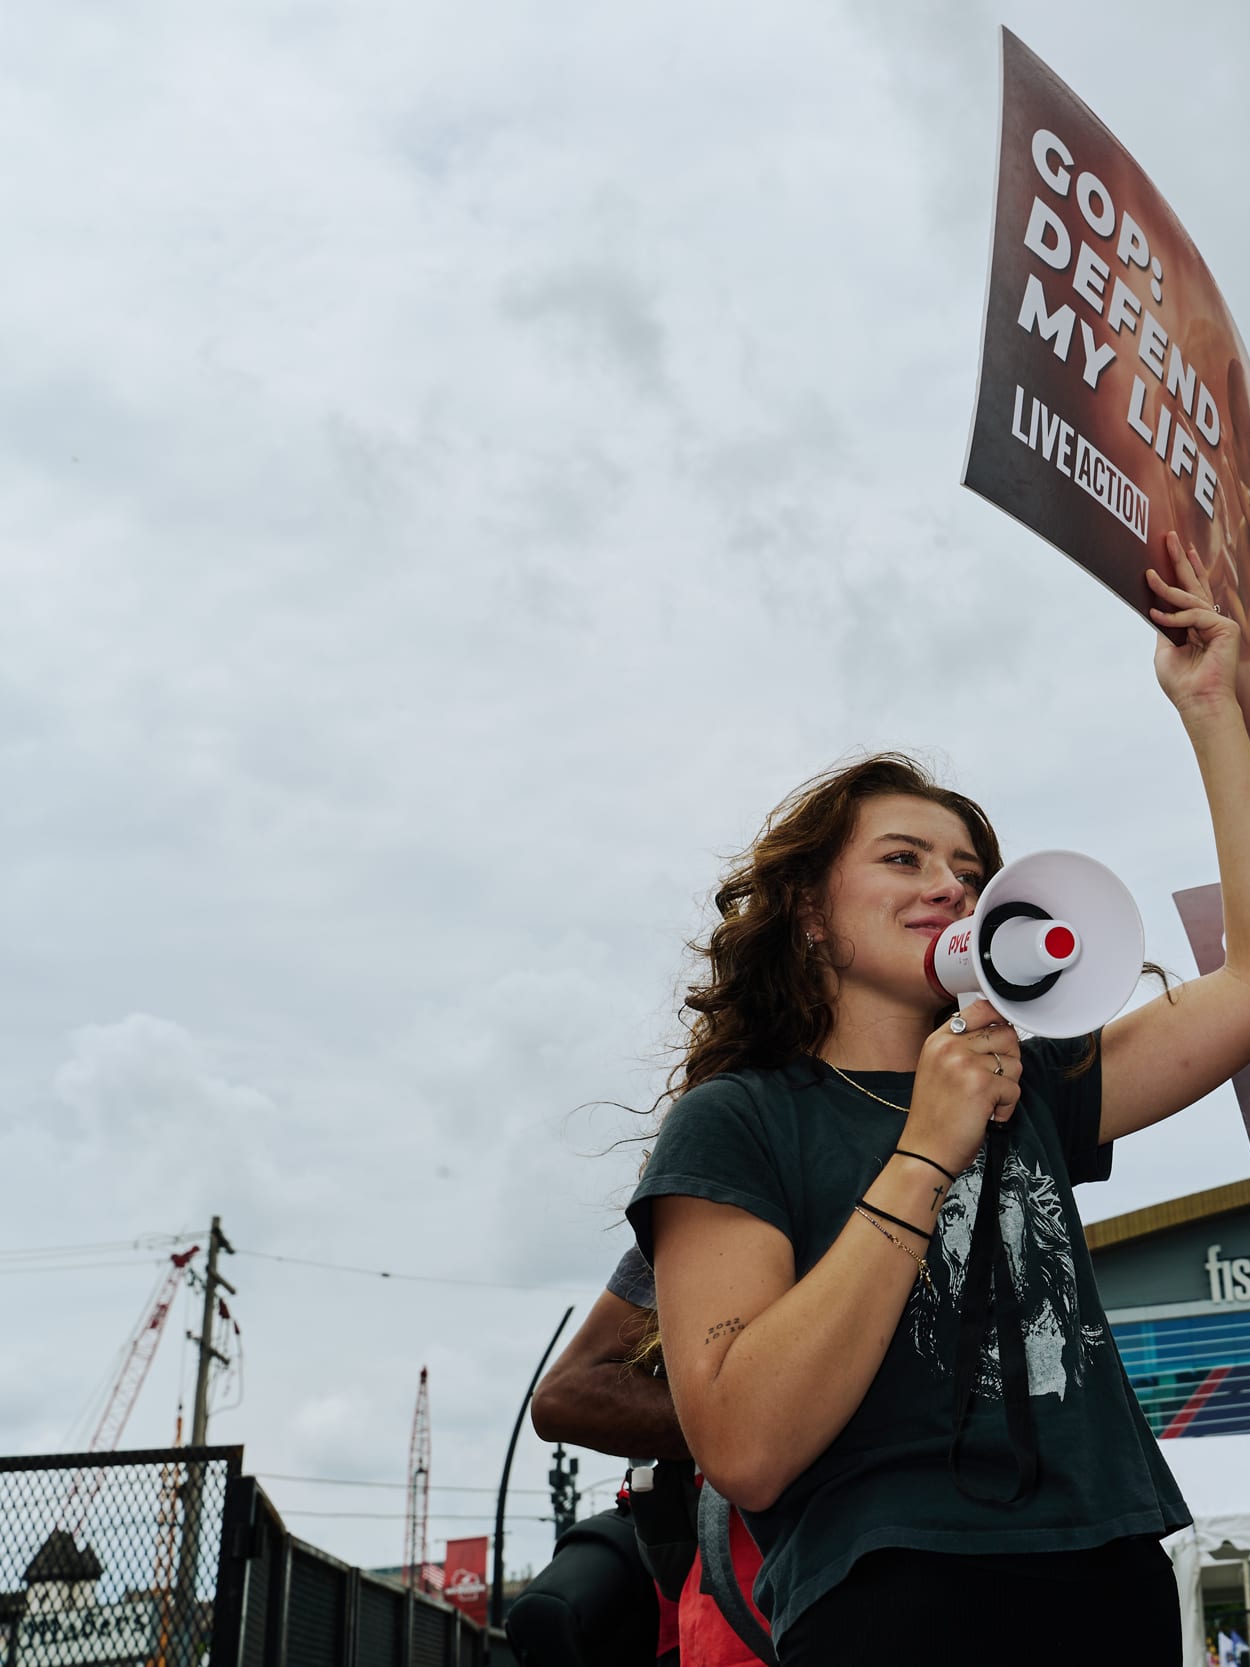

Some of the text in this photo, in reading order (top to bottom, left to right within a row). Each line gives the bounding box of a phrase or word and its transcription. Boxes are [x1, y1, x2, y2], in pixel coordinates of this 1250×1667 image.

[1032, 129, 1162, 302] GOP:
[1017, 273, 1217, 519] MY LIFE
[1024, 196, 1220, 446] DEFEND
[1012, 384, 1147, 538] LIVE ACTION
